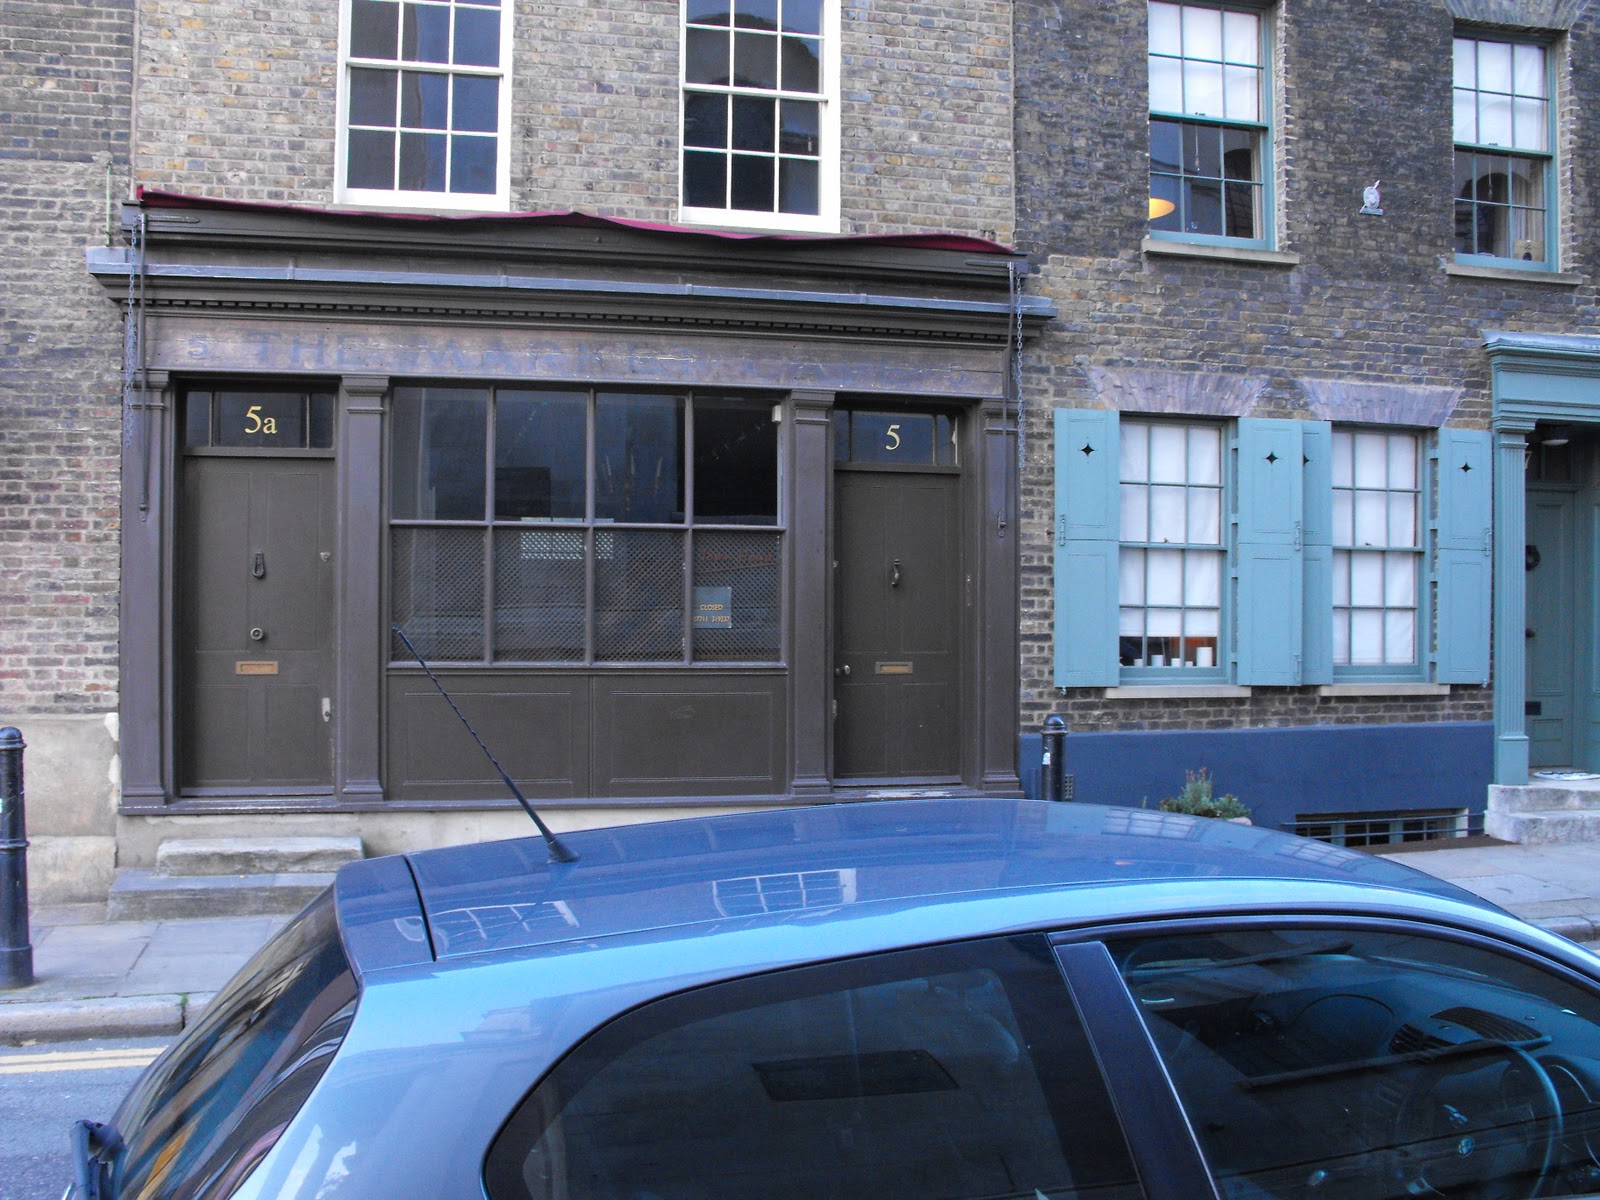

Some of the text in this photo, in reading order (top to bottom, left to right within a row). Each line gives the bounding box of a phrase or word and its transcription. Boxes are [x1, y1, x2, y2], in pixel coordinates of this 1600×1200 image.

[245, 331, 371, 366] THE
[244, 405, 277, 434] 5a
[885, 424, 900, 450] 5
